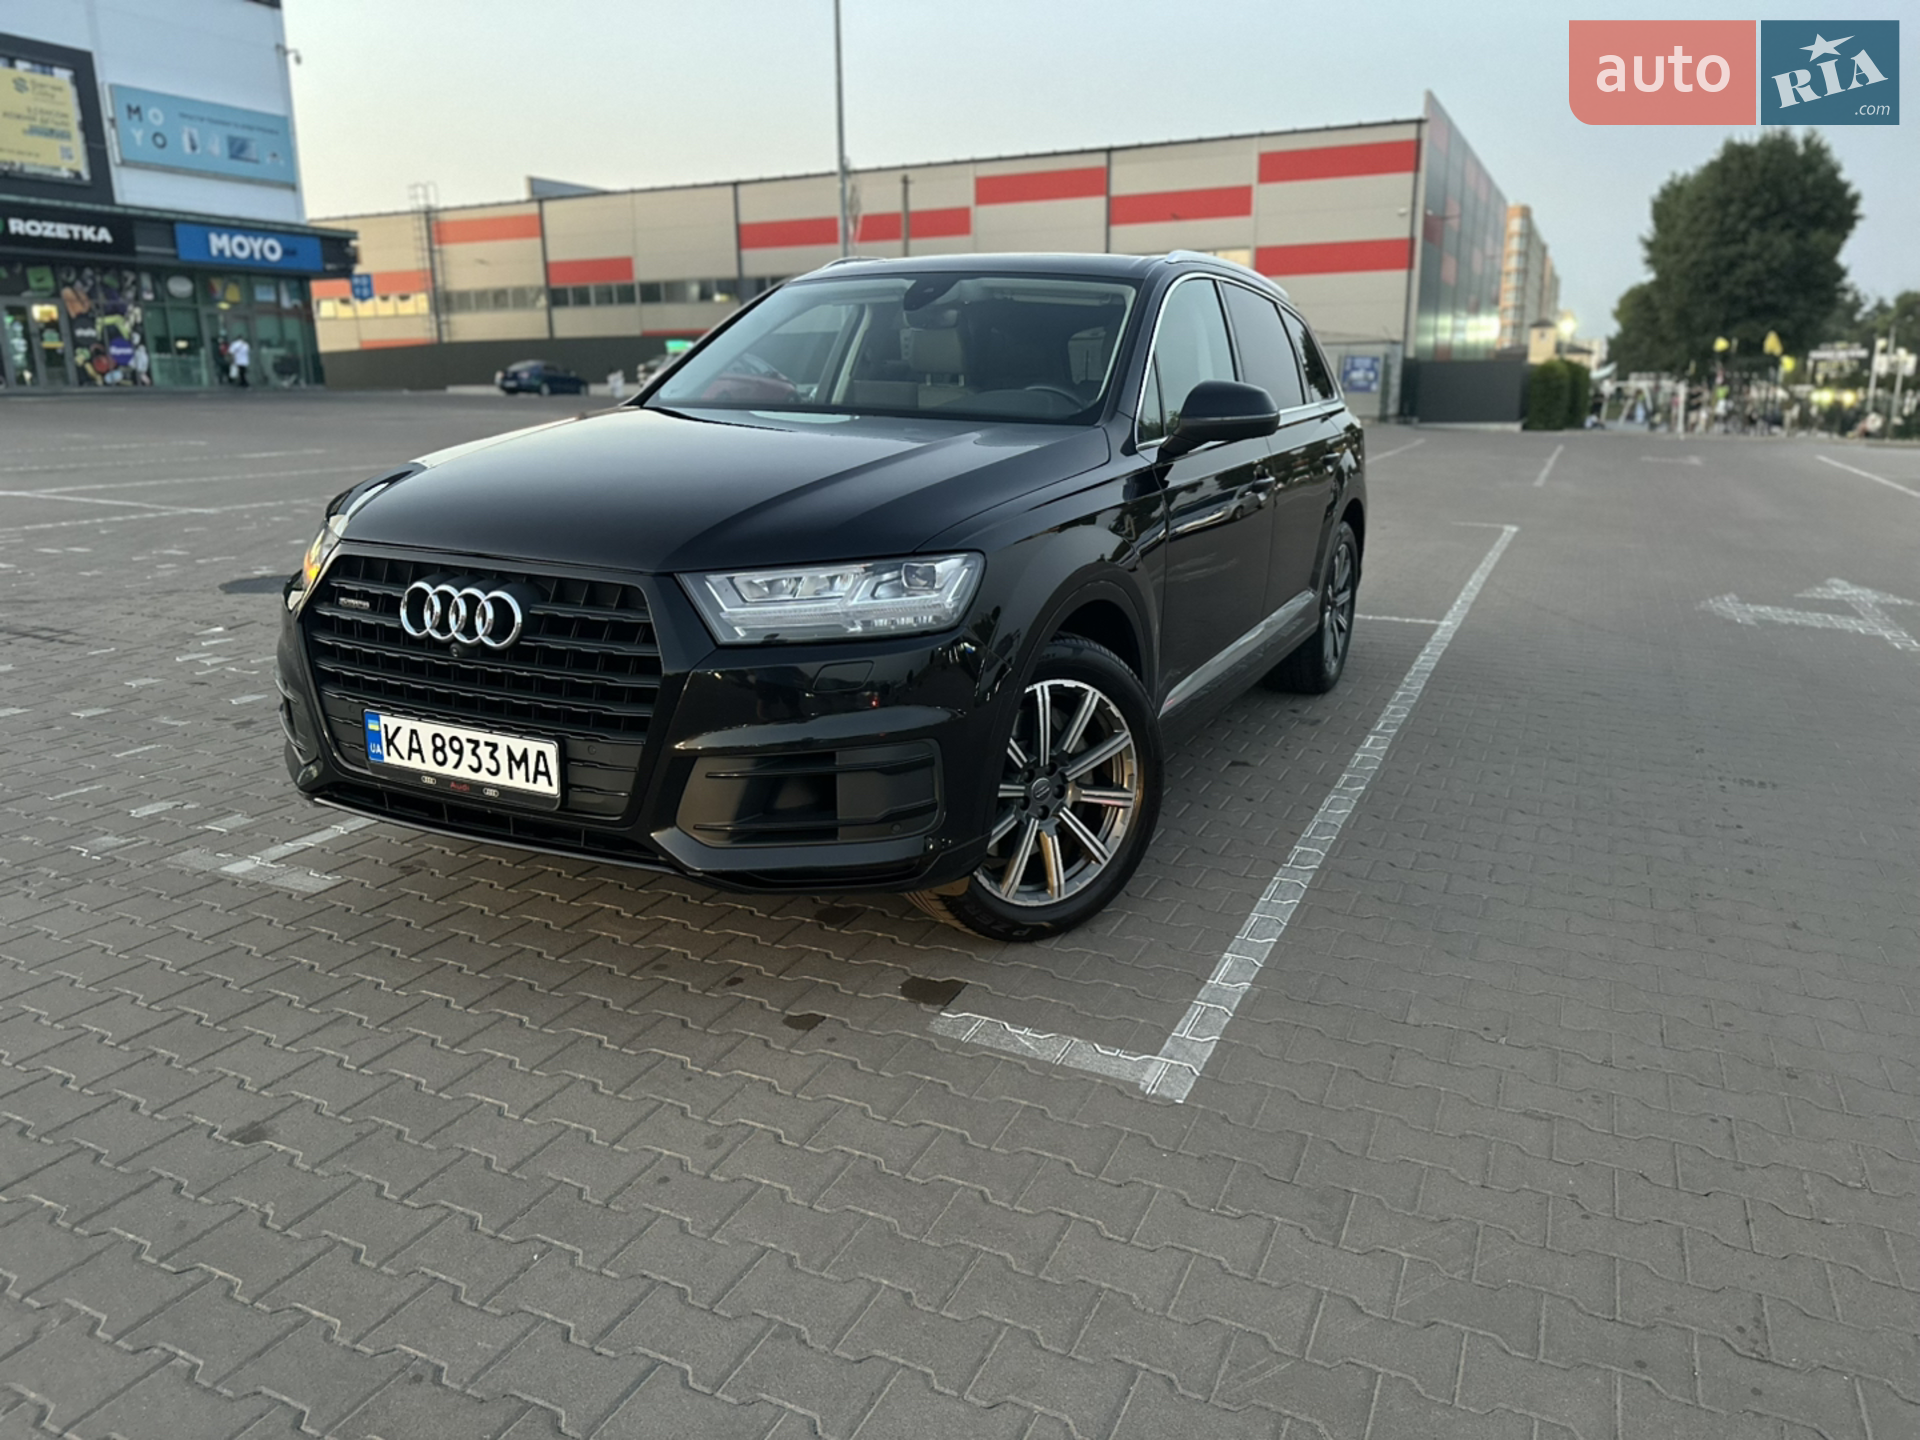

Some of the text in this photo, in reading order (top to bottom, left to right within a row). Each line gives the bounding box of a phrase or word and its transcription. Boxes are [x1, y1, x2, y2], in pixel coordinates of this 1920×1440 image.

[8, 217, 114, 244] ROZETKA
[208, 232, 283, 262] MOYO
[370, 742, 382, 755] UA
[383, 723, 553, 787] KA 8933 MA
